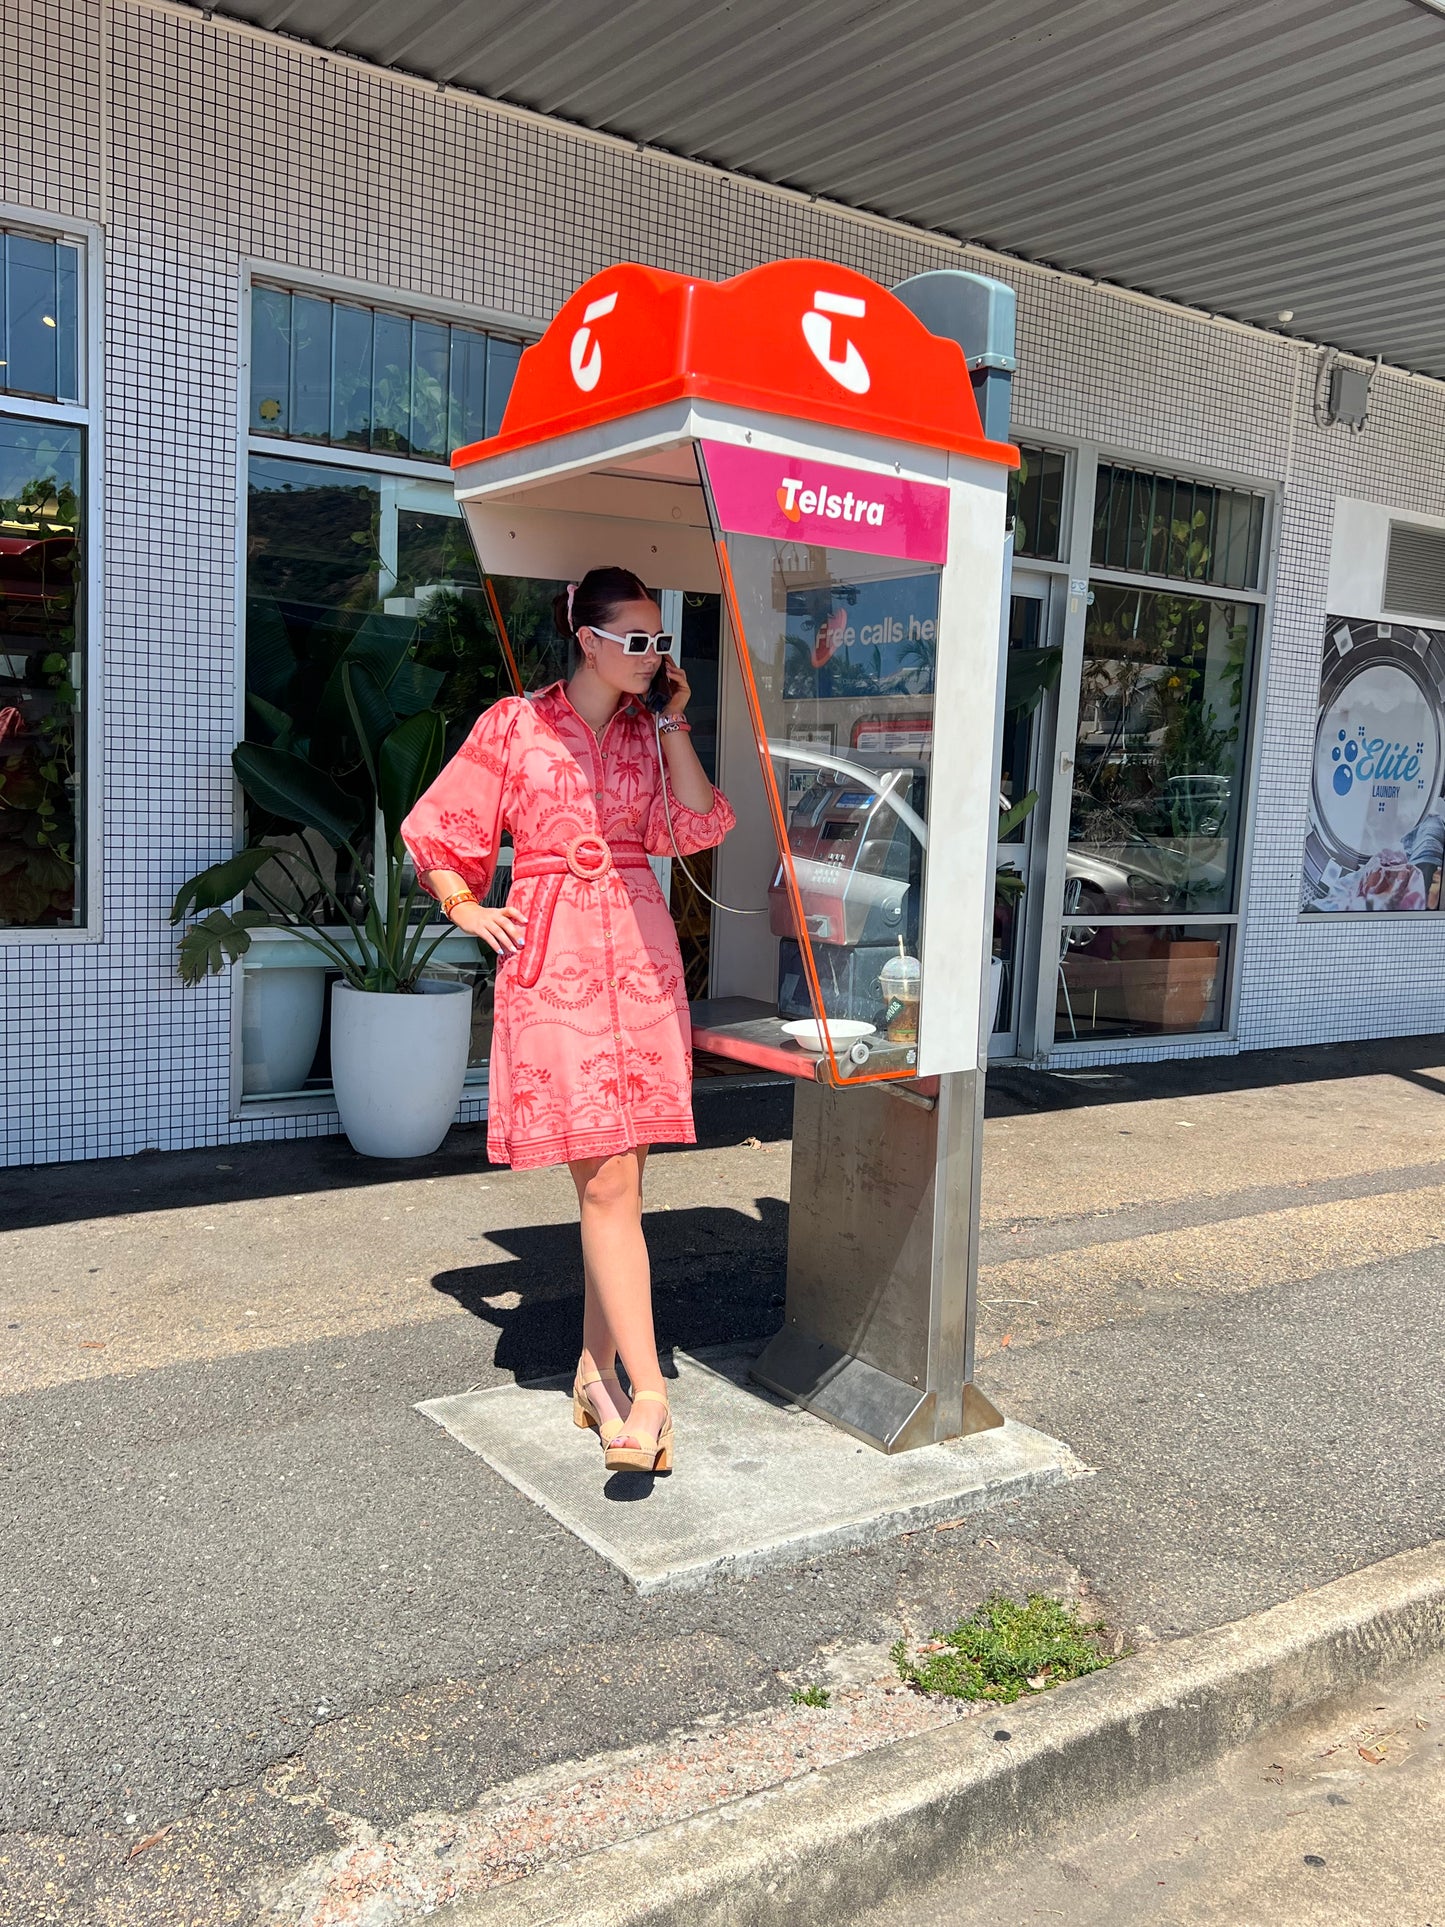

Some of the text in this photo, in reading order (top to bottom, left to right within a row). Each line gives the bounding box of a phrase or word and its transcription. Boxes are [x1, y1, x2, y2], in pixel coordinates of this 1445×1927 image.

[781, 477, 885, 526] Telstra
[815, 623, 856, 649] Free
[860, 616, 903, 645] calls
[1355, 738, 1421, 782] Elite
[1372, 785, 1400, 798] LAUNDRY
